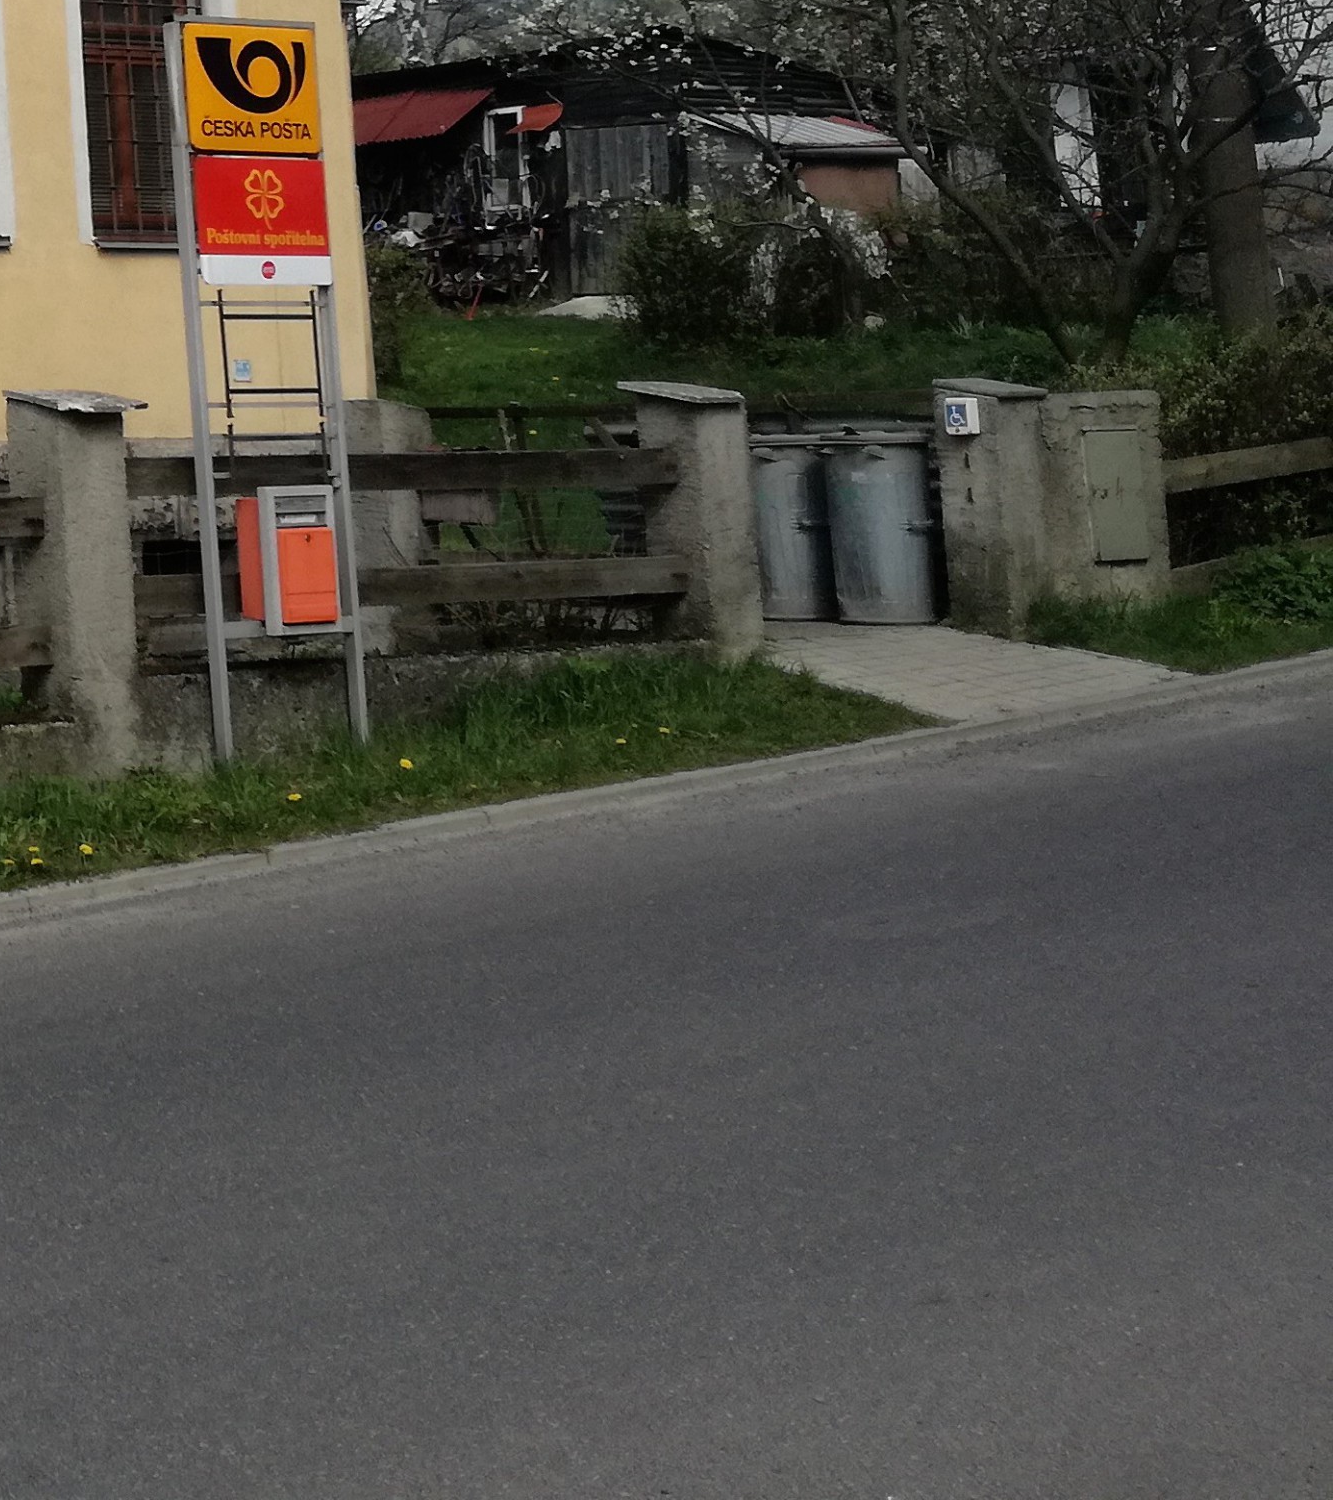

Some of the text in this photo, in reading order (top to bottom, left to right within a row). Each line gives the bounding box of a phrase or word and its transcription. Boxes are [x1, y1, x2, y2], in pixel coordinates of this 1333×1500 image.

[201, 115, 312, 140] ČESKÁ POŠTA
[206, 226, 325, 249] Poštovní spořitelna
